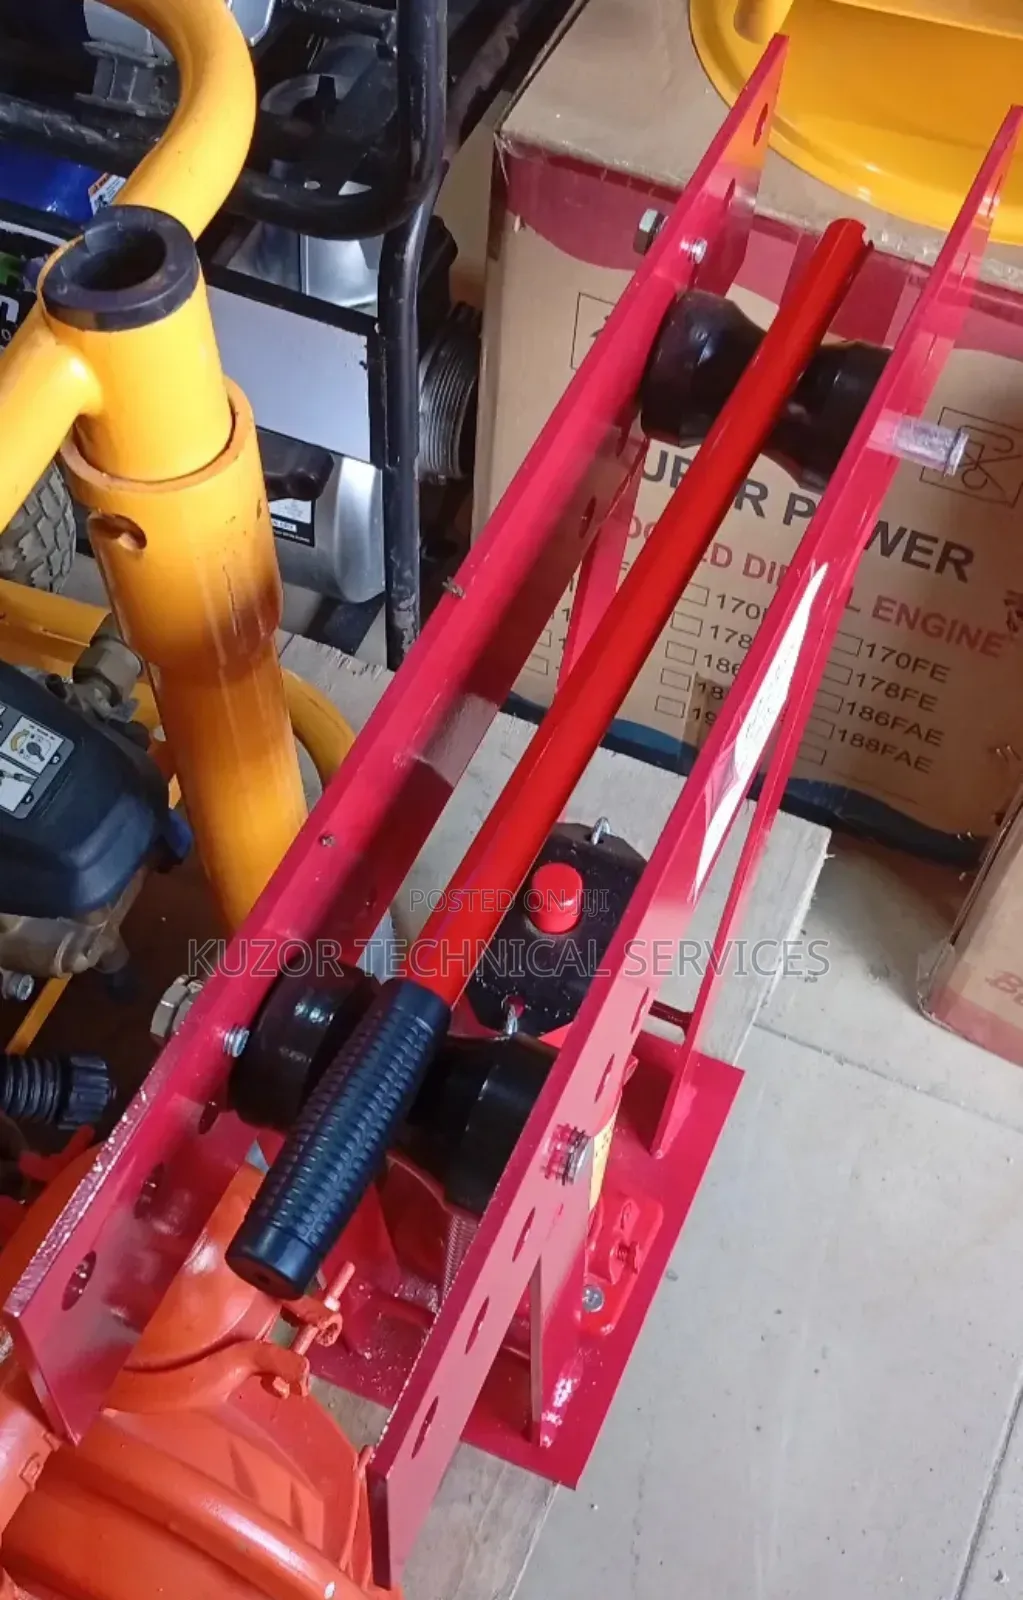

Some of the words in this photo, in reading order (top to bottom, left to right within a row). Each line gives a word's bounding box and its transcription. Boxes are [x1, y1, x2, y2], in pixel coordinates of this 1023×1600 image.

[642, 449, 769, 518] UPR
[783, 492, 975, 584] PWER
[716, 593, 767, 621] 170
[872, 595, 1007, 659] ENGINE
[865, 643, 951, 684] 170FE
[856, 672, 939, 713] 178FE
[846, 701, 945, 747] 186FAE
[837, 729, 934, 775] 188FAE
